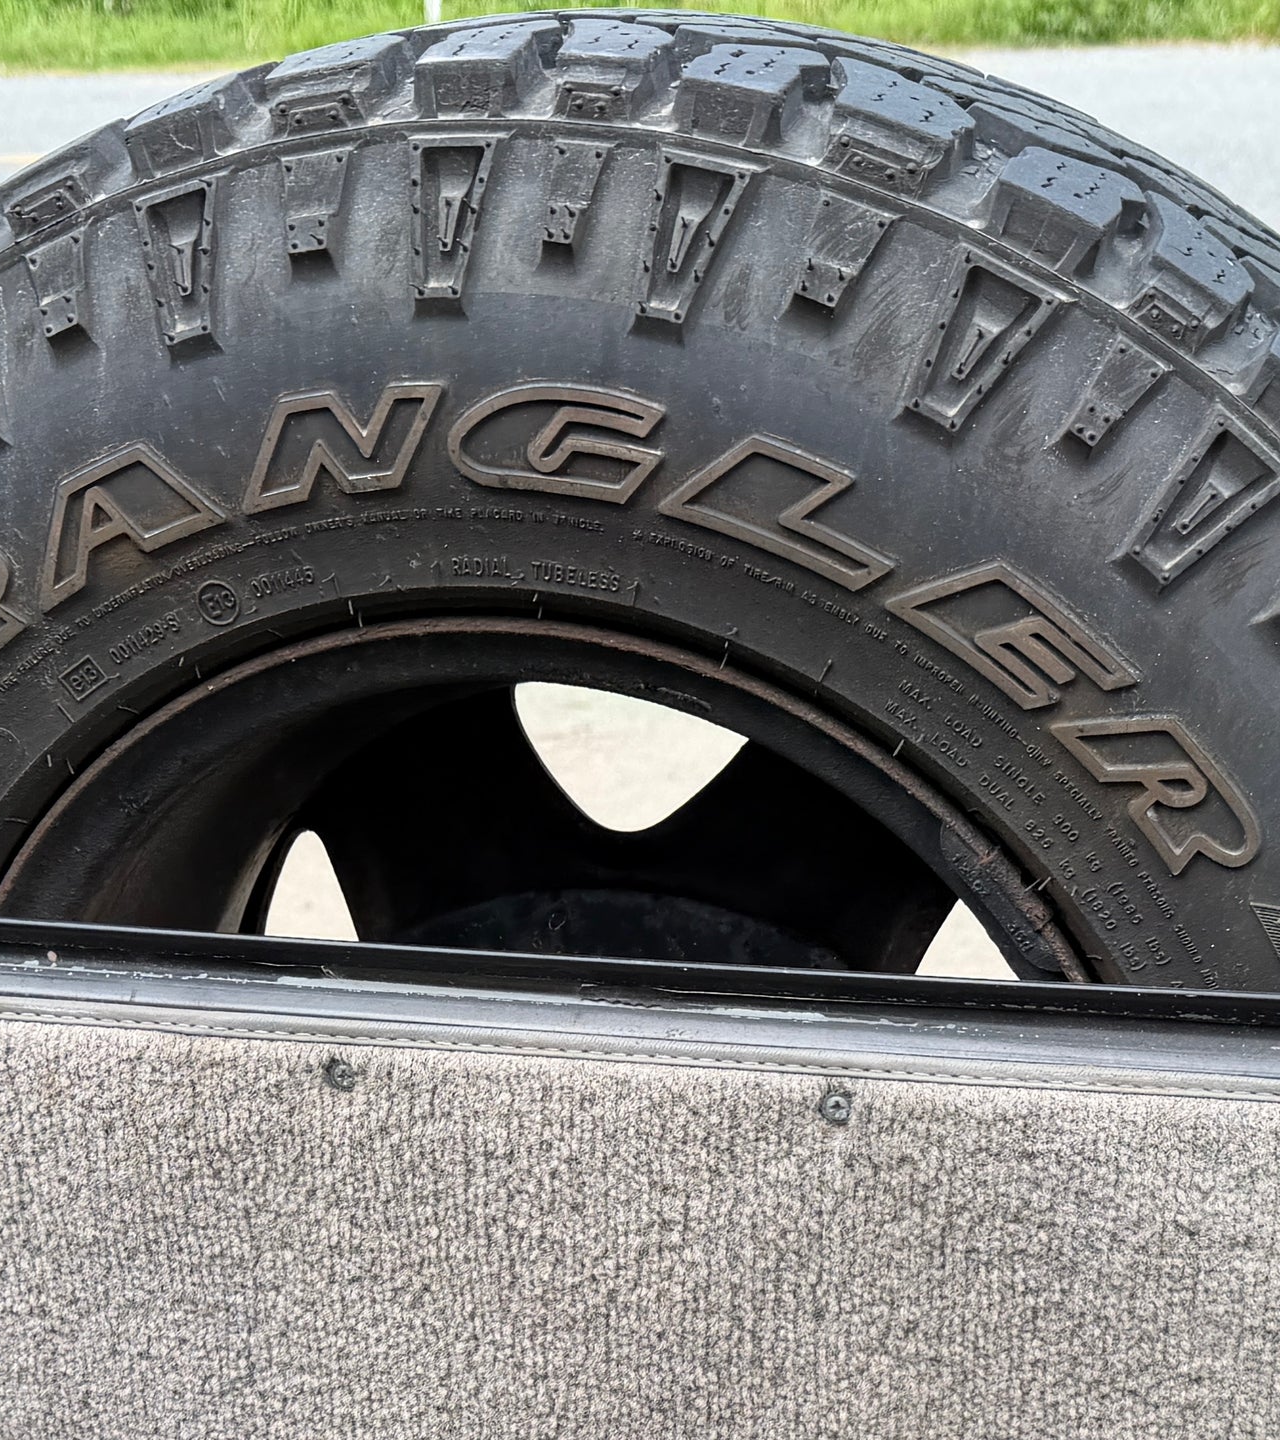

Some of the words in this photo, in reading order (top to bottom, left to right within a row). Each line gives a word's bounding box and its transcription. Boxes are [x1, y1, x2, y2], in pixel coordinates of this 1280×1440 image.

[451, 556, 511, 578] RADIAL
[531, 561, 620, 592] TUBELESS
[929, 732, 969, 767] LOAD
[978, 773, 1017, 811] DUAL
[943, 715, 983, 749] LOAD
[994, 755, 1048, 806] SINGLE
[1053, 813, 1080, 843] 900
